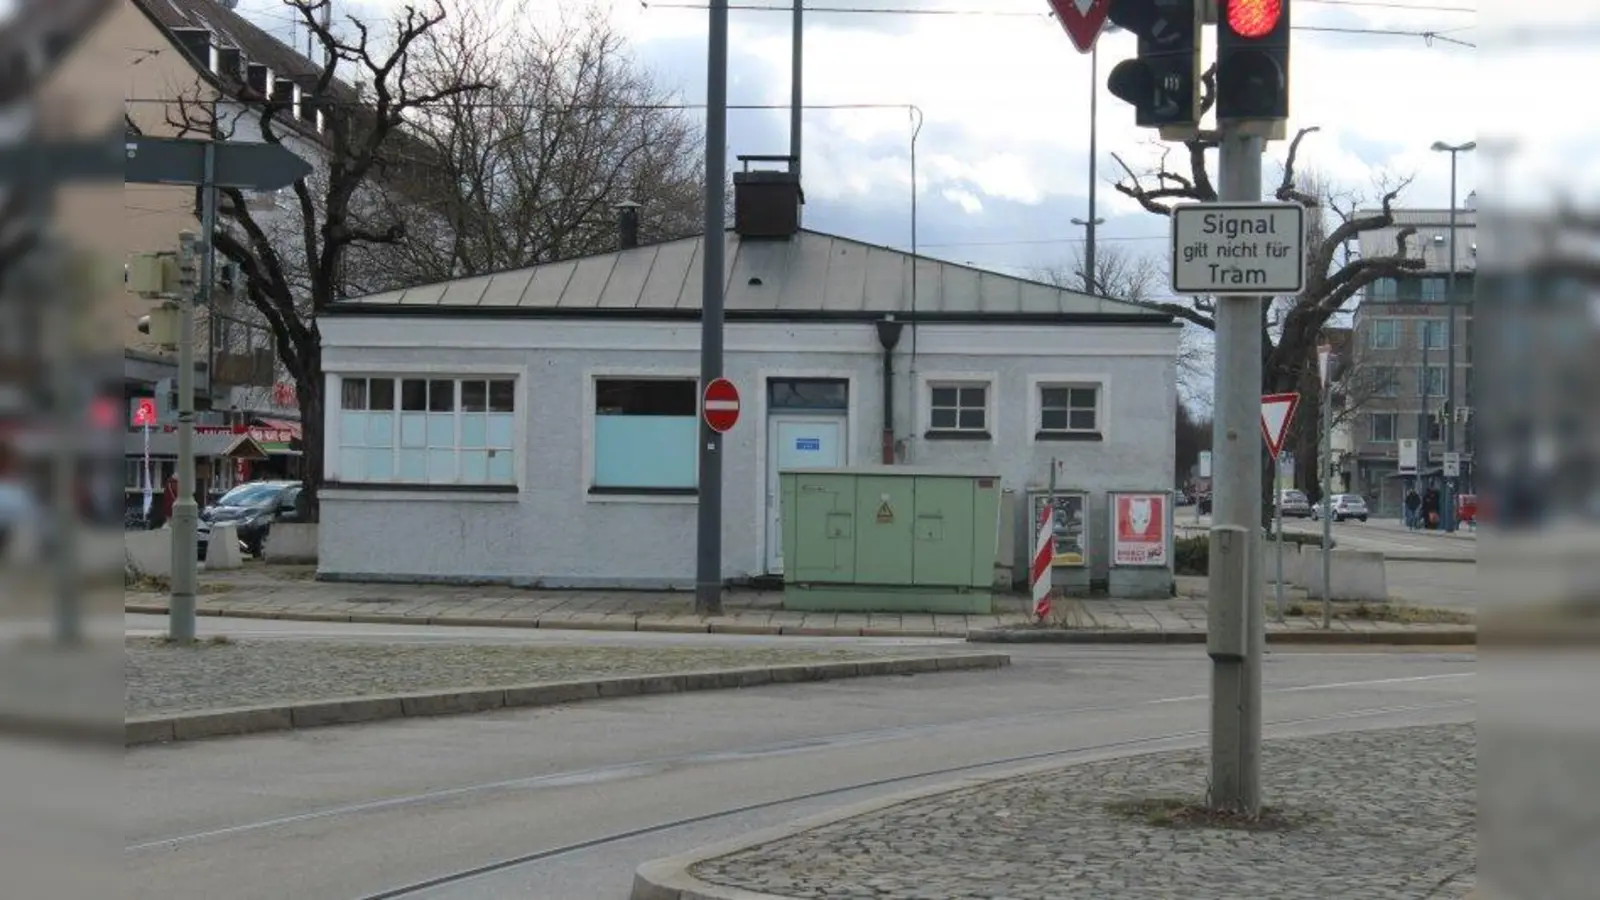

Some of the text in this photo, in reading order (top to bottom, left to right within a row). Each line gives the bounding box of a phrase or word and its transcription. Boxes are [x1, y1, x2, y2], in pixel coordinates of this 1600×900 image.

[1203, 213, 1276, 239] Signal
[1183, 241, 1292, 262] gilt nicht für
[1208, 264, 1267, 285] Tram
